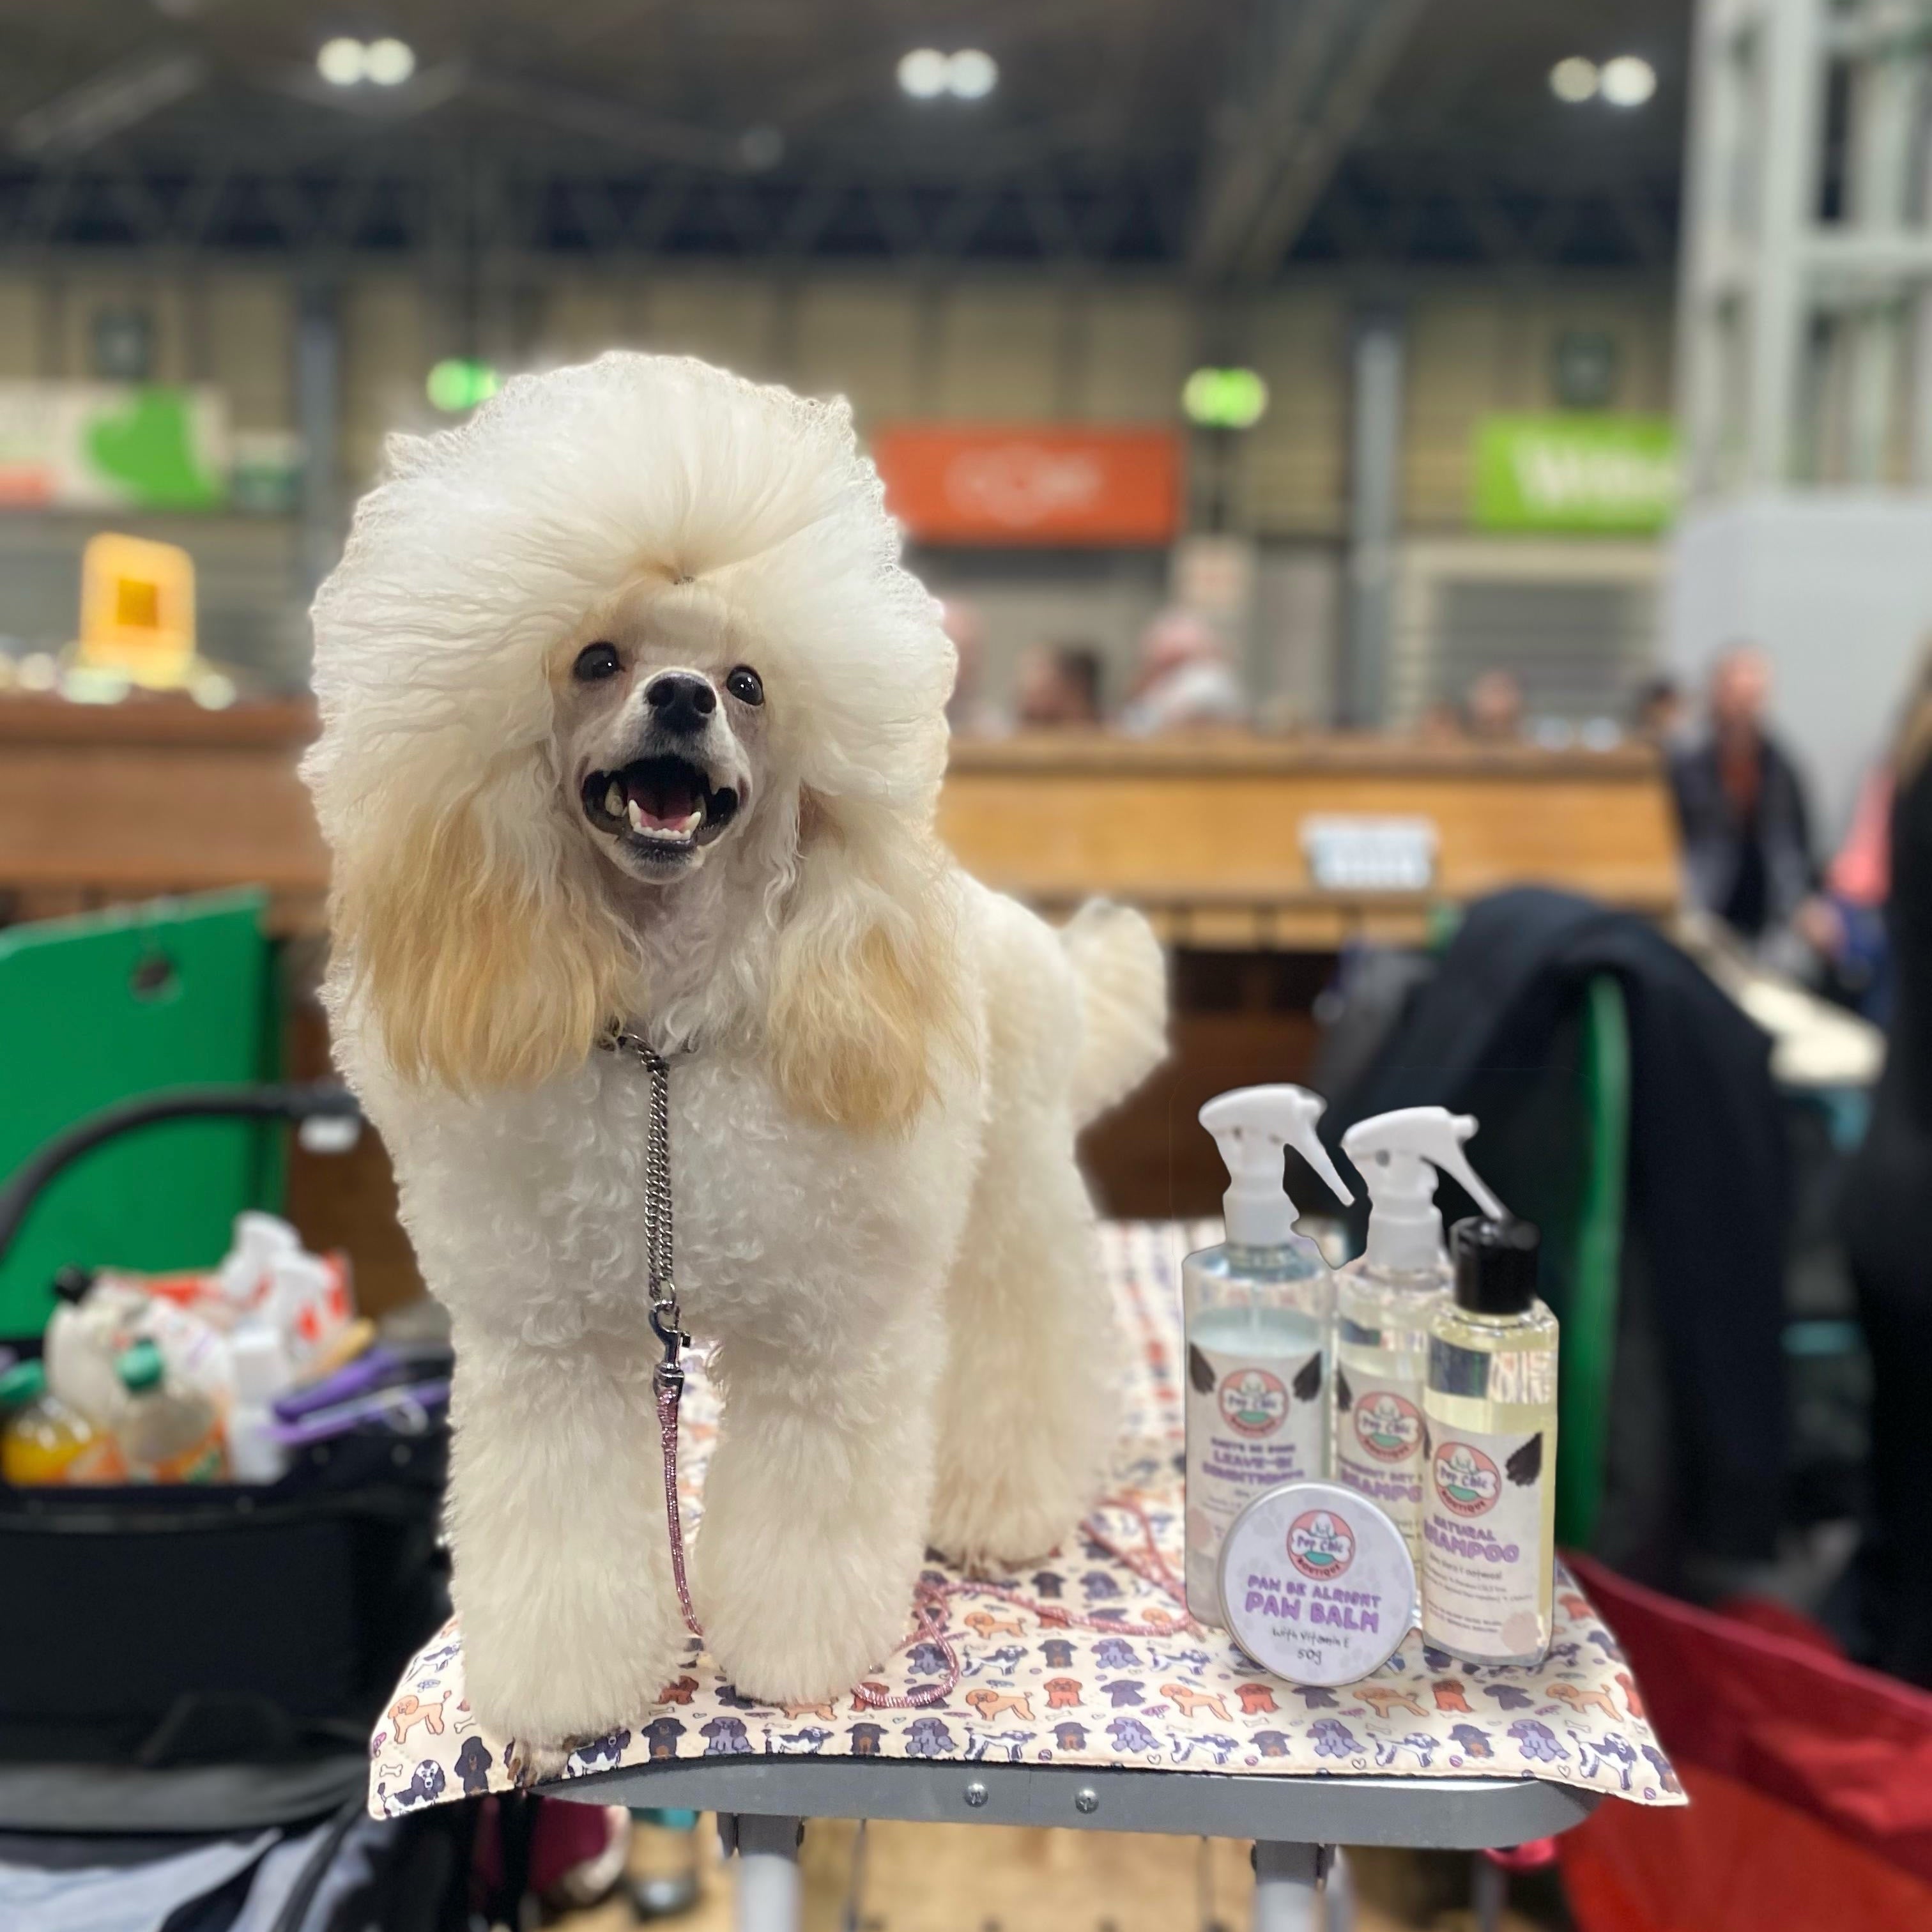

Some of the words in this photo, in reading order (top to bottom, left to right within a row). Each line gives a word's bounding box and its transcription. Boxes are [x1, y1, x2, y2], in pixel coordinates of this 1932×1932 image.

[1342, 1468, 1423, 1502] HAMPO
[1245, 1591, 1301, 1621] PAW
[1310, 1601, 1379, 1634] BALM
[1272, 1627, 1298, 1642] with
[1297, 1648, 1322, 1666] 50g
